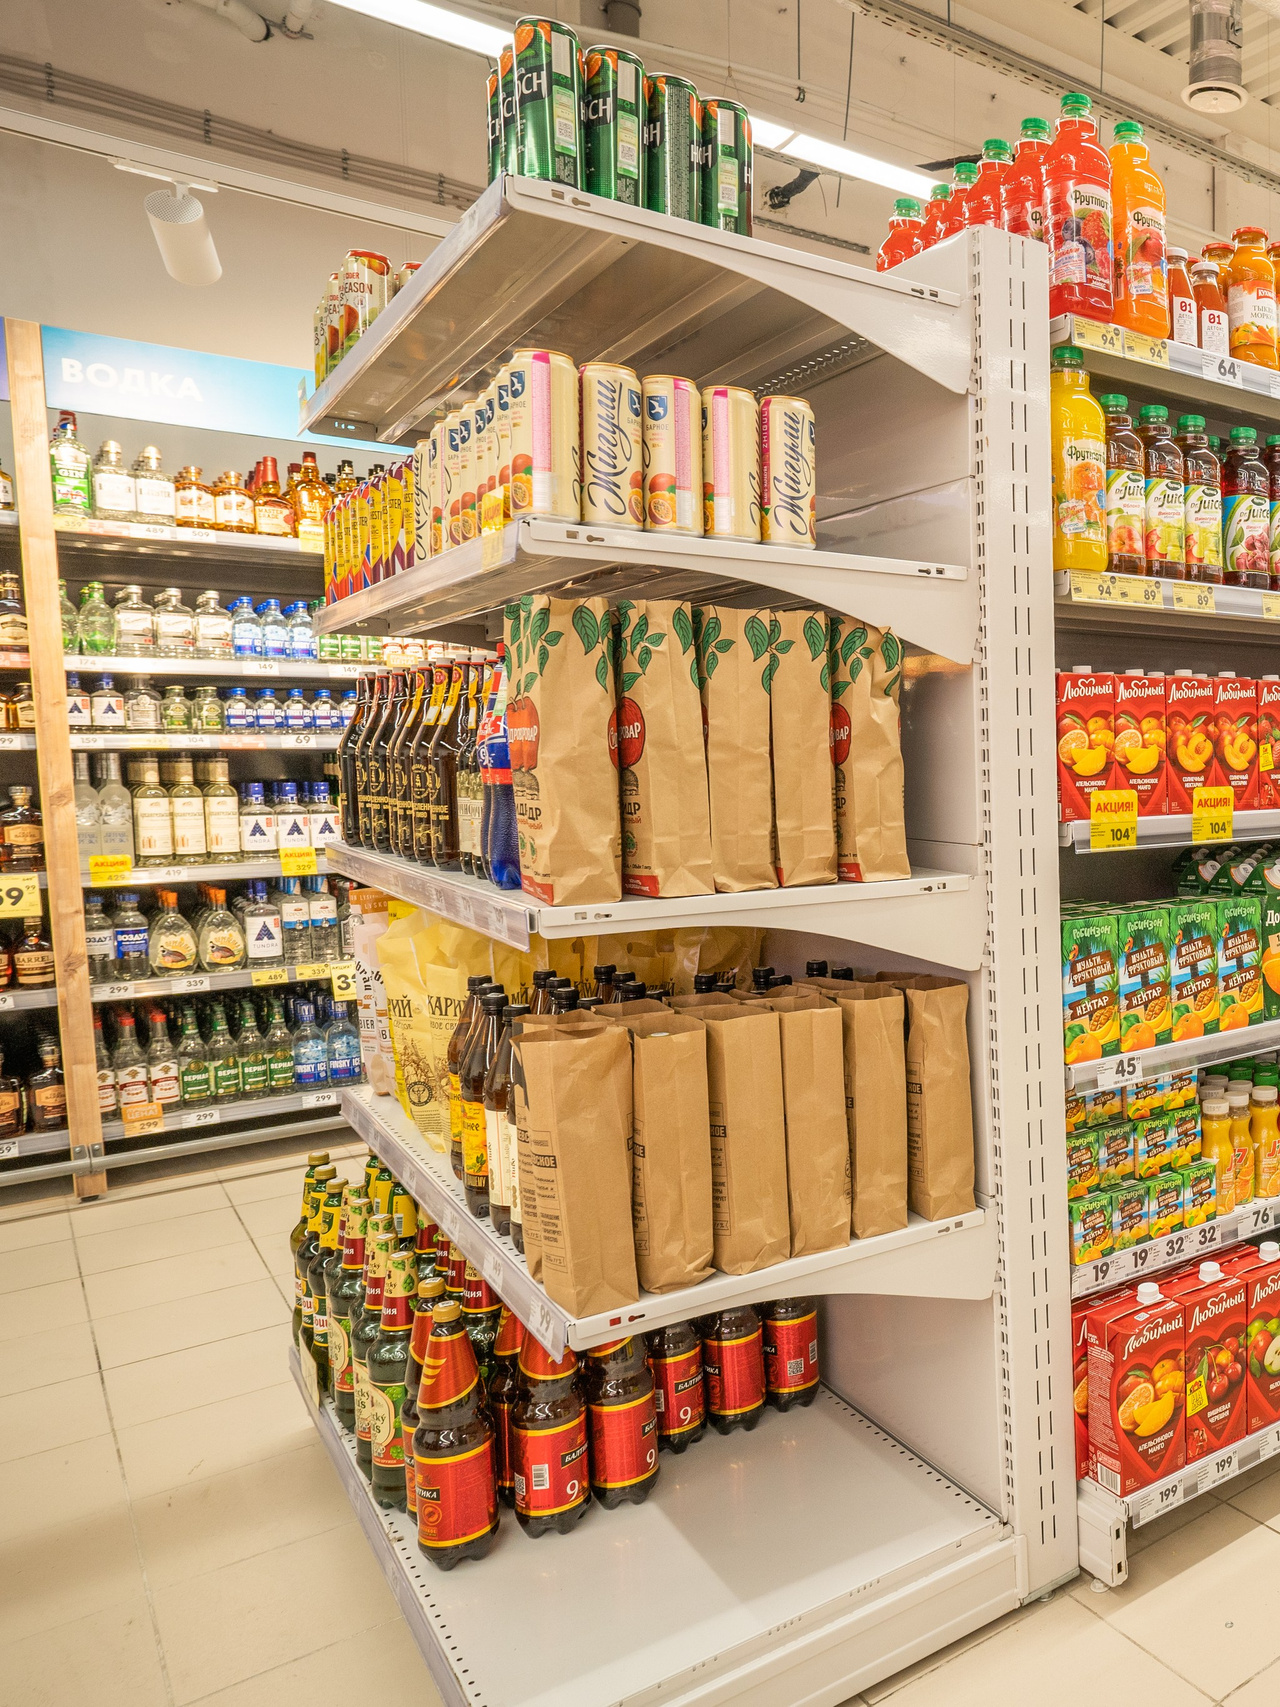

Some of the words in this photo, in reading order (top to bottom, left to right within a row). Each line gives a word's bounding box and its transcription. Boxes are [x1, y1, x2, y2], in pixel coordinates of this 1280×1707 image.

[1102, 334, 1115, 347] 94
[1150, 347, 1162, 359] 94
[1218, 360, 1236, 378] 64
[61, 357, 203, 402] ВОДКА
[587, 380, 631, 515] Жигули
[774, 411, 811, 536] Жигули
[1246, 505, 1270, 521] Juice
[1098, 585, 1111, 597] 94
[1144, 589, 1156, 601] 89
[1197, 595, 1209, 606] 89
[258, 663, 273, 671] 149
[343, 666, 357, 674] 149
[1062, 677, 1113, 702] Любимый
[1116, 678, 1164, 703] Любимый
[1168, 680, 1213, 705] Любимый
[1216, 682, 1256, 705] Любимый
[295, 735, 310, 745] 69
[1095, 801, 1134, 813] АКЦИЯ!
[1197, 797, 1230, 808] АКЦИЯ!
[1111, 828, 1129, 841] 104
[1210, 822, 1226, 835] 104
[93, 859, 127, 869] АКЦИЯ!
[284, 852, 312, 860] АКЦИЯ!
[1178, 948, 1213, 966] ФРУКТОВЫЙ
[1073, 964, 1112, 983] ФРУКТОВЫЙ
[1128, 957, 1165, 974] ФРУКТОВЫЙ
[186, 979, 204, 987] 339
[269, 973, 283, 981] 489
[1228, 970, 1255, 988] НЕКТАР
[110, 985, 129, 994] 299
[1182, 978, 1211, 996] НЕКТАР
[1132, 987, 1162, 1006] НЕКТАР
[1076, 996, 1109, 1015] НЕКТАР
[1116, 1058, 1136, 1076] 45
[315, 1094, 331, 1103] 299
[197, 1112, 214, 1121] 299
[139, 1121, 158, 1130] 299
[1254, 1211, 1269, 1226] 76
[1199, 1229, 1216, 1244] 32
[1167, 1238, 1184, 1256] 32
[1132, 1251, 1147, 1268] 19
[1092, 1265, 1109, 1281] 19
[1189, 1289, 1245, 1333] Любимый
[1123, 1314, 1183, 1360] Любимый
[680, 1407, 692, 1425] 9
[1208, 1403, 1230, 1418] ВИШНЕВАЯ
[1209, 1410, 1229, 1423] ЧЕРЕШНЯ
[1138, 1430, 1174, 1452] АПЕЛЬСИНОВОЕ
[1148, 1443, 1164, 1454] МАНГО
[645, 1449, 656, 1469] 9
[1216, 1456, 1232, 1473] 199
[567, 1480, 579, 1501] 9
[1160, 1484, 1177, 1503] 199
